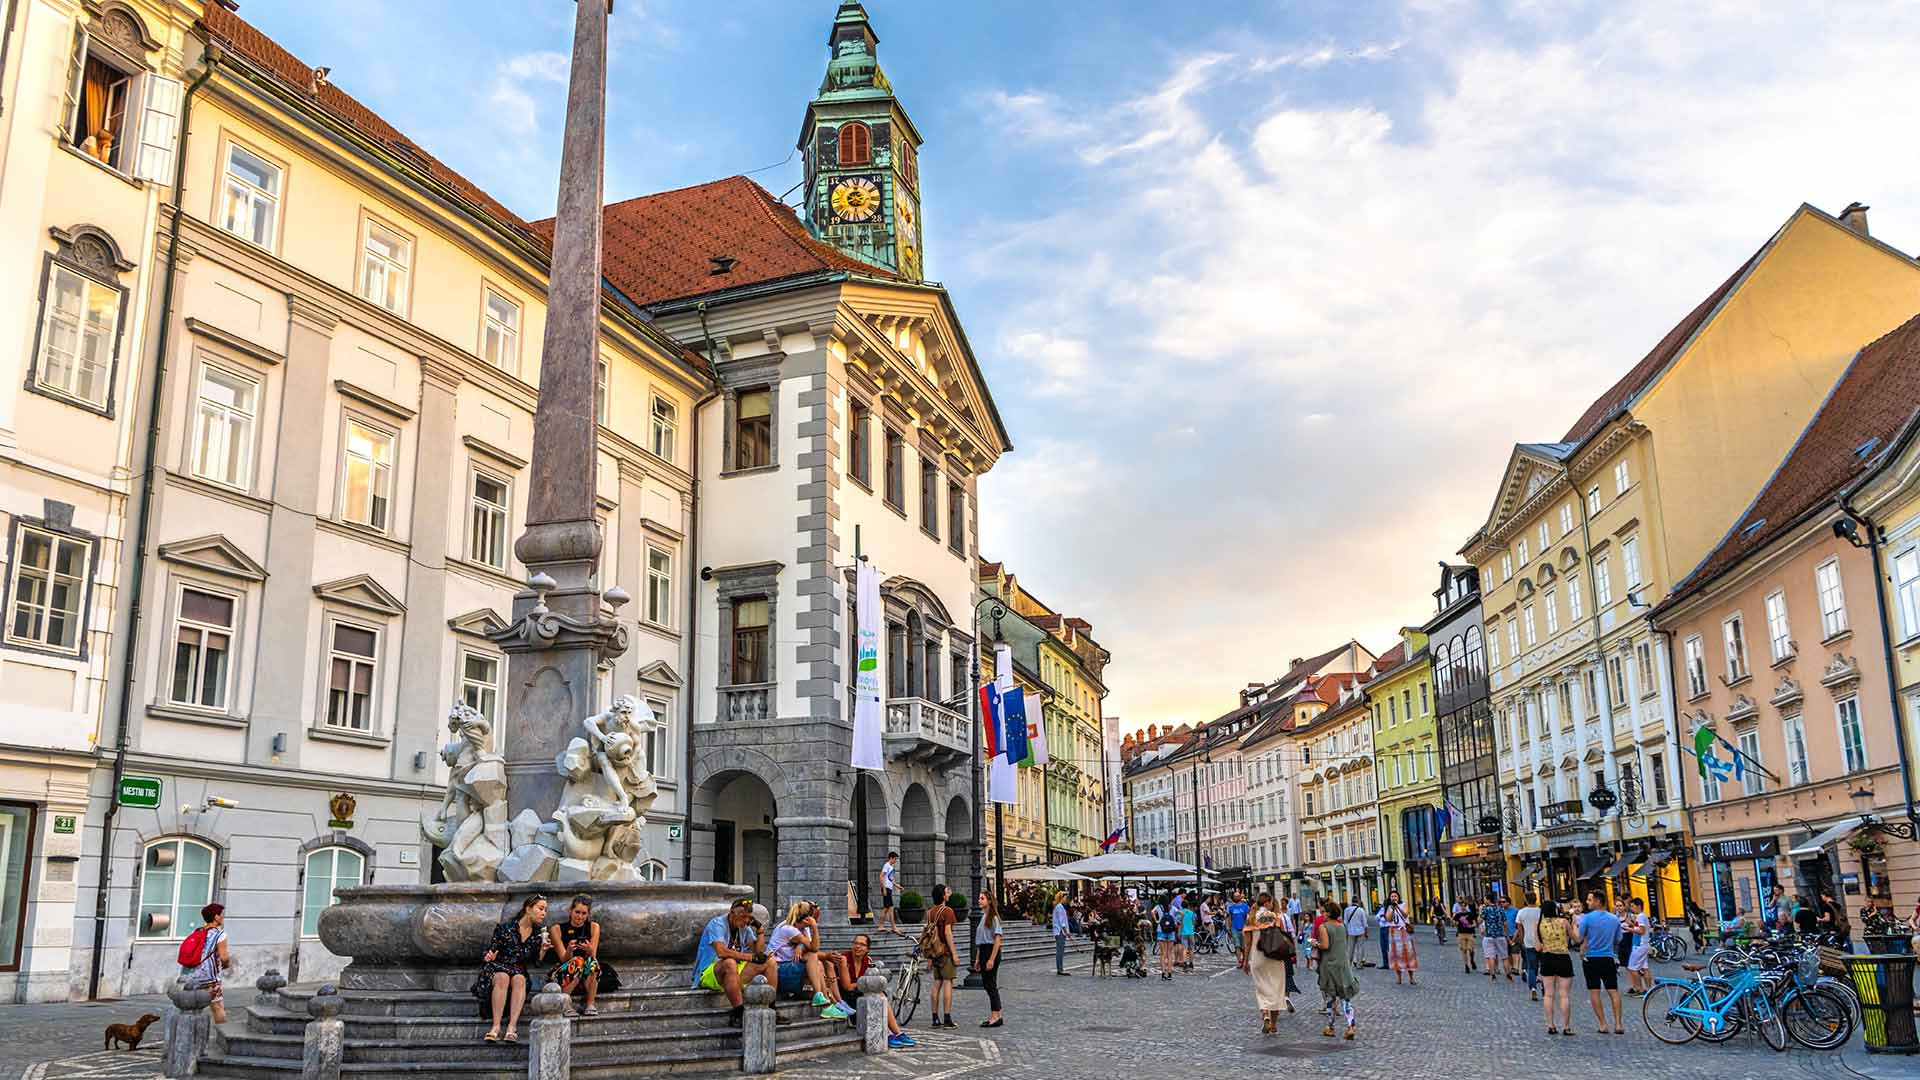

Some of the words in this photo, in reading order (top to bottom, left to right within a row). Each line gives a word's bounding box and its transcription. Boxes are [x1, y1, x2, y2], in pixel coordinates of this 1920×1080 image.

[123, 786, 145, 797] MESTNI
[145, 788, 157, 798] TRG
[1720, 839, 1753, 857] FOOTBALL
